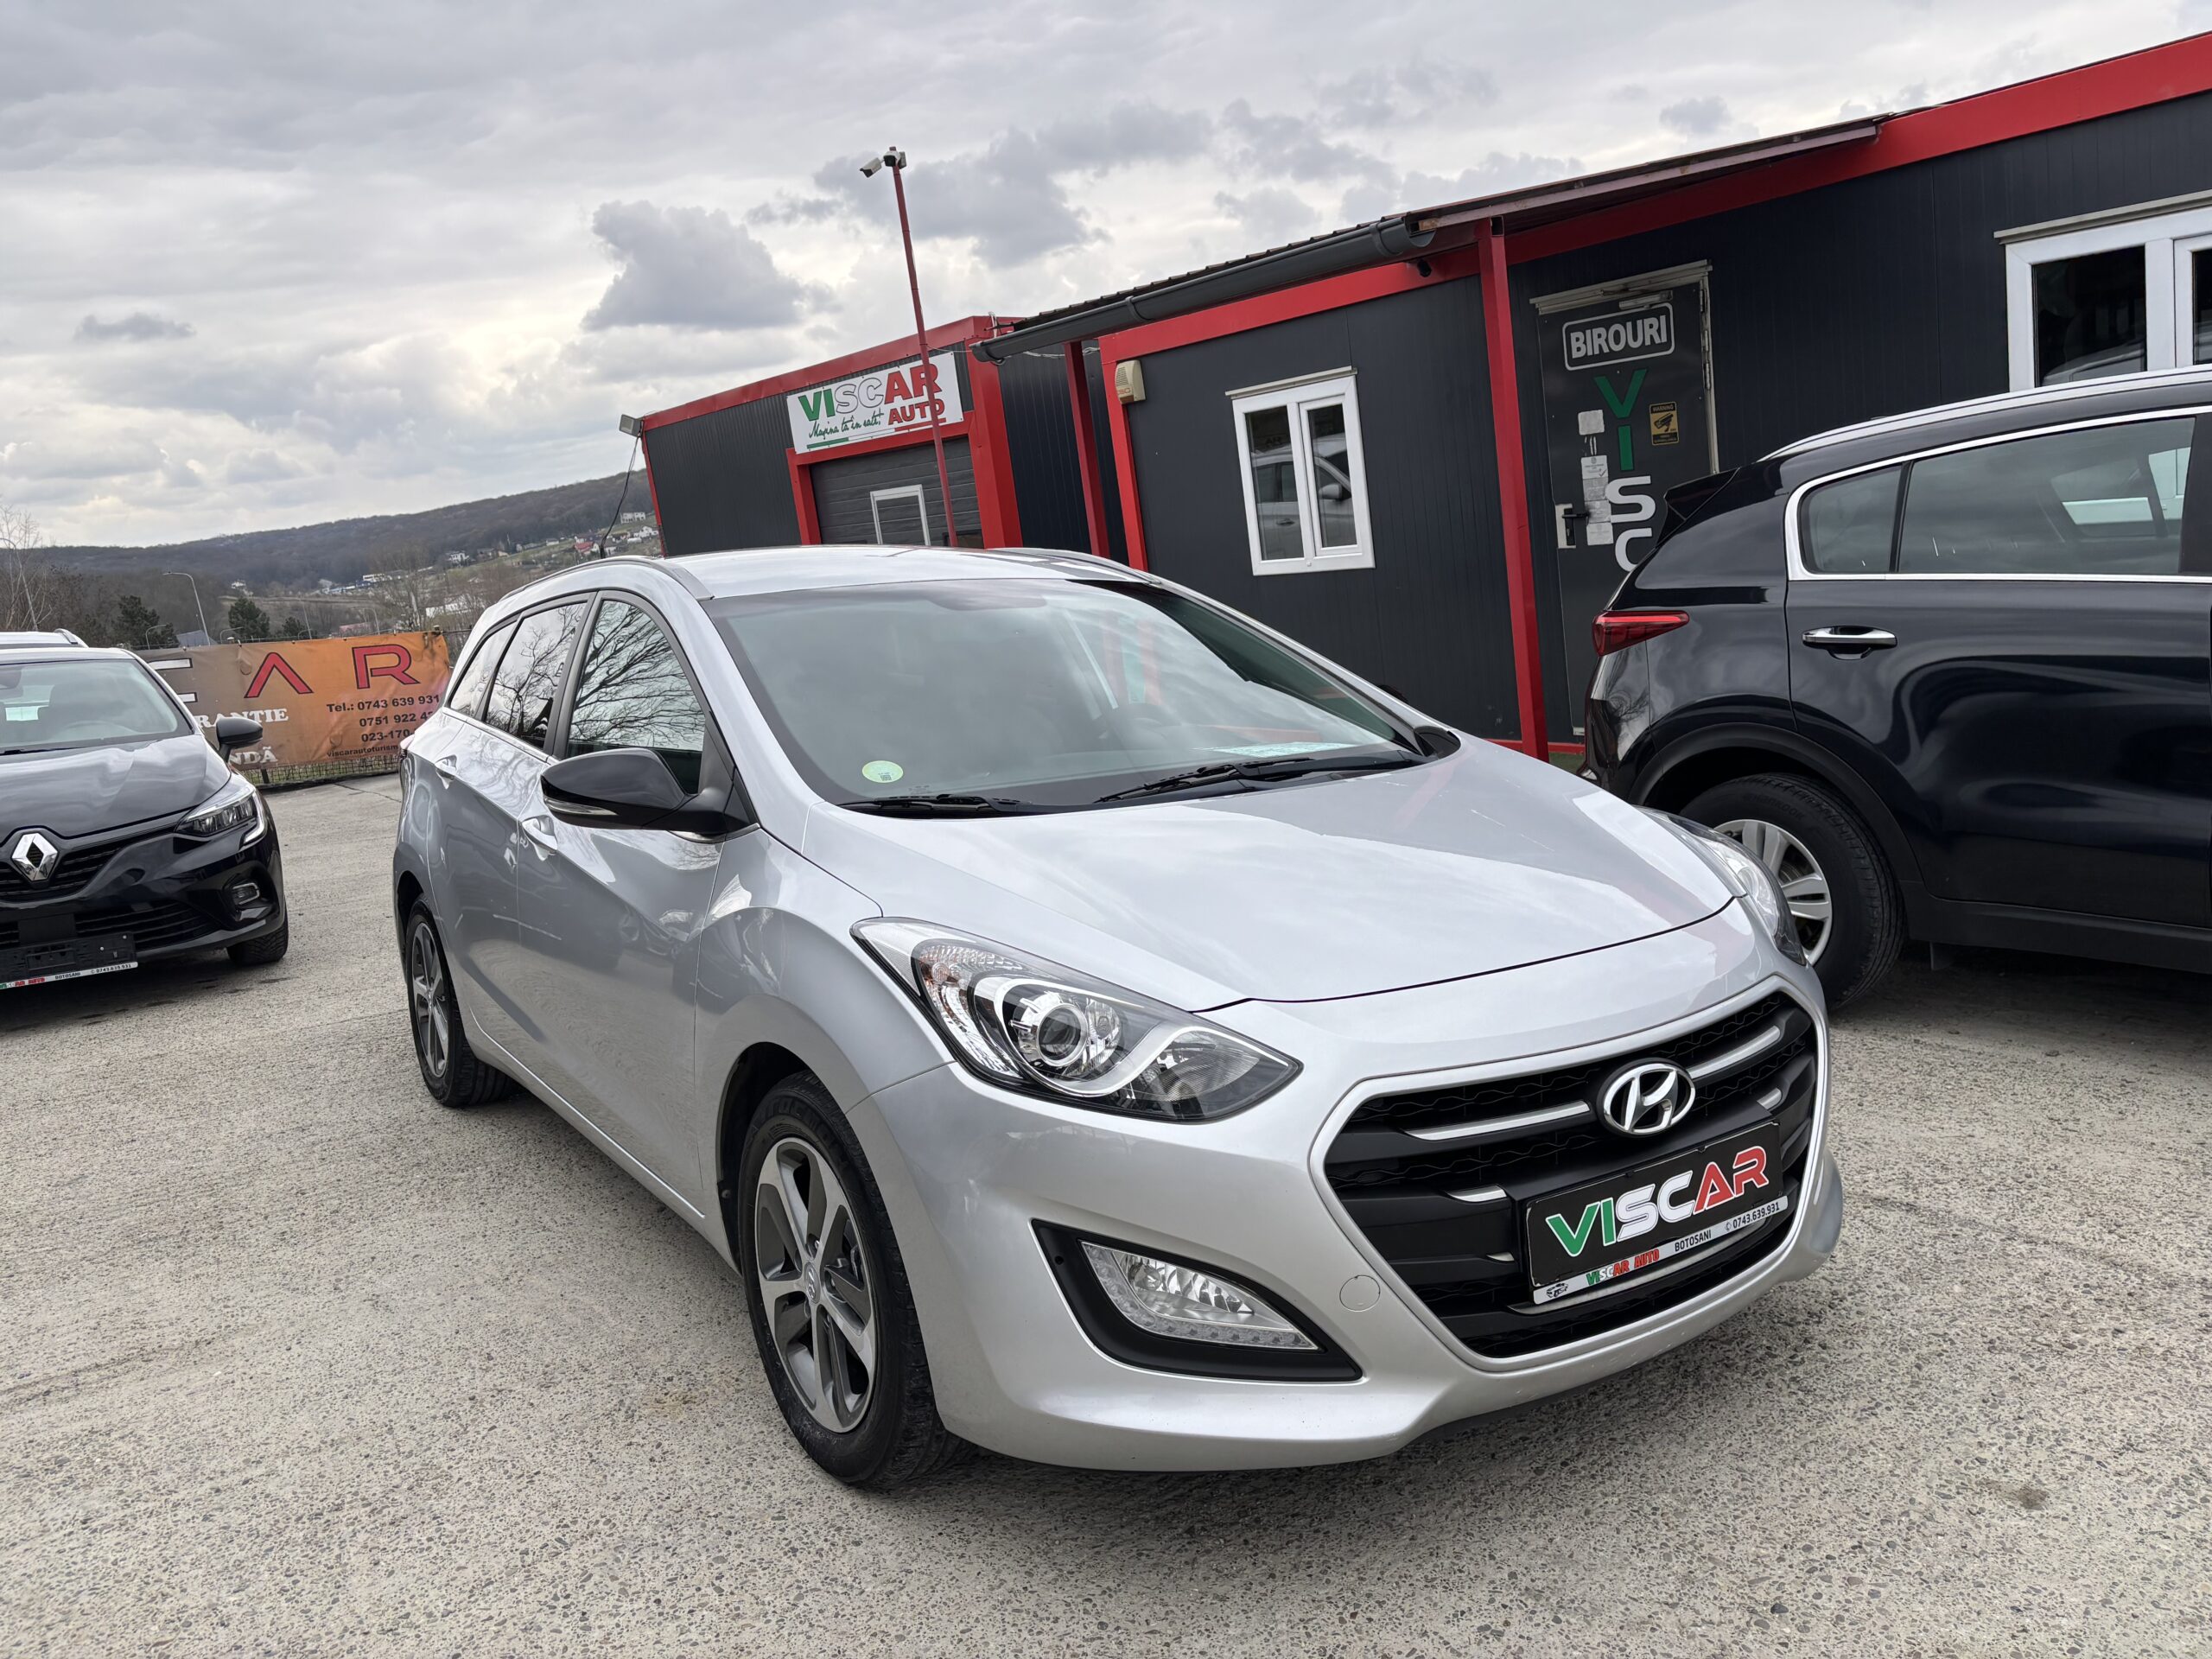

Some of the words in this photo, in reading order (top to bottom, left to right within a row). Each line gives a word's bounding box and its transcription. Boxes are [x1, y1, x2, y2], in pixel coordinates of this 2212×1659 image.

[1570, 315, 1669, 359] BIROURI
[798, 363, 943, 422] VISCAR
[888, 398, 945, 426] AUTO
[327, 702, 354, 713] Tel.:
[357, 699, 388, 711] 0743
[391, 696, 415, 708] 639
[417, 694, 440, 704] 931
[359, 715, 389, 728] 0751
[393, 713, 416, 724] 922
[1545, 1146, 1770, 1257] VISCAR
[1586, 1260, 1630, 1287] VISCAR
[1634, 1249, 1660, 1268] AUTO
[1675, 1230, 1712, 1252] BOTOSANI
[1732, 1202, 1780, 1229] 0743.639.931
